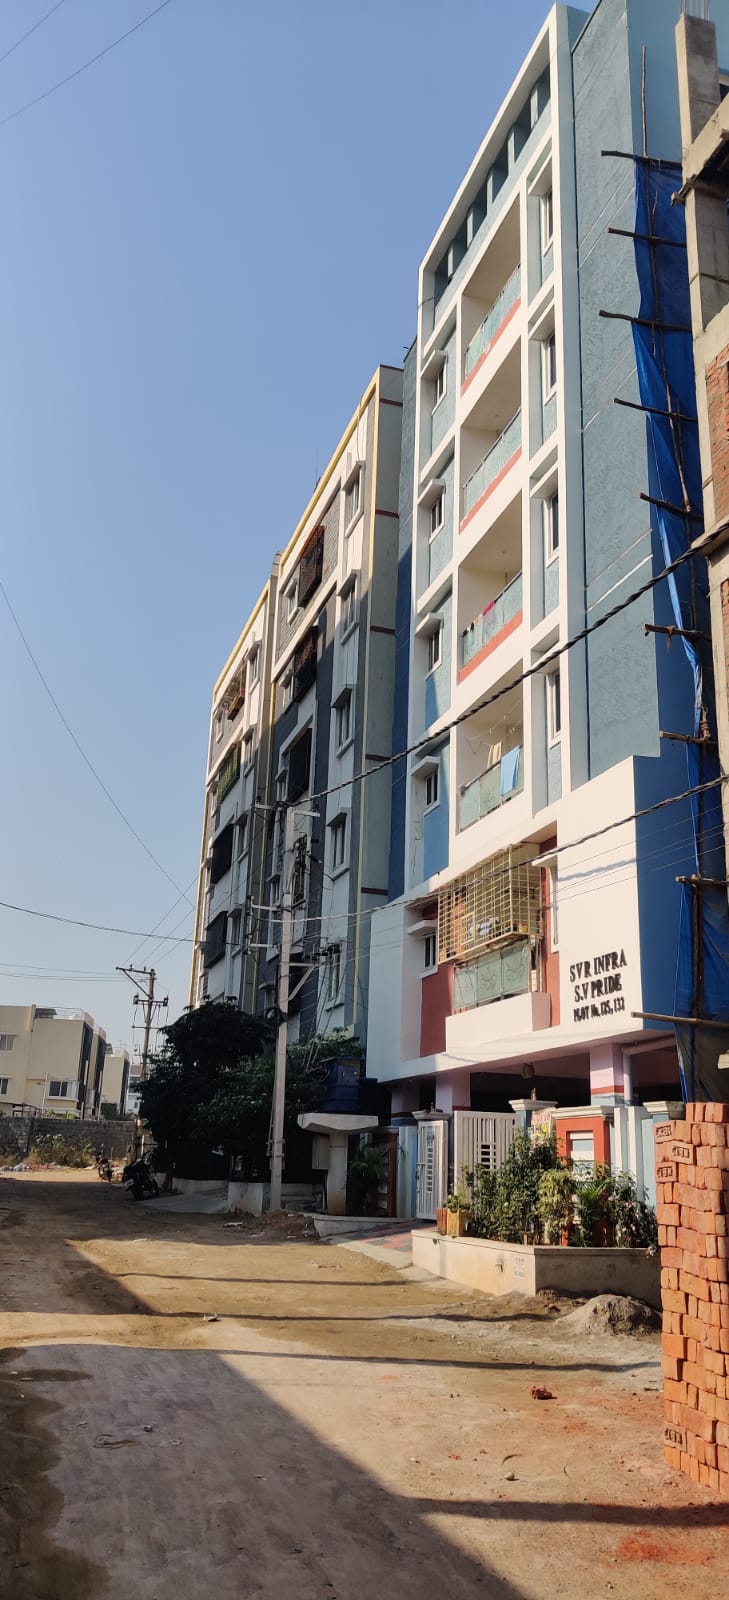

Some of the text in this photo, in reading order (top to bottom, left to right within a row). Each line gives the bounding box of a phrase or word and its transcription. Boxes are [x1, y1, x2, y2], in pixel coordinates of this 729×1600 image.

[593, 949, 627, 976] INFRA
[590, 972, 622, 999] PRIDE
[573, 1005, 590, 1023] PLOT
